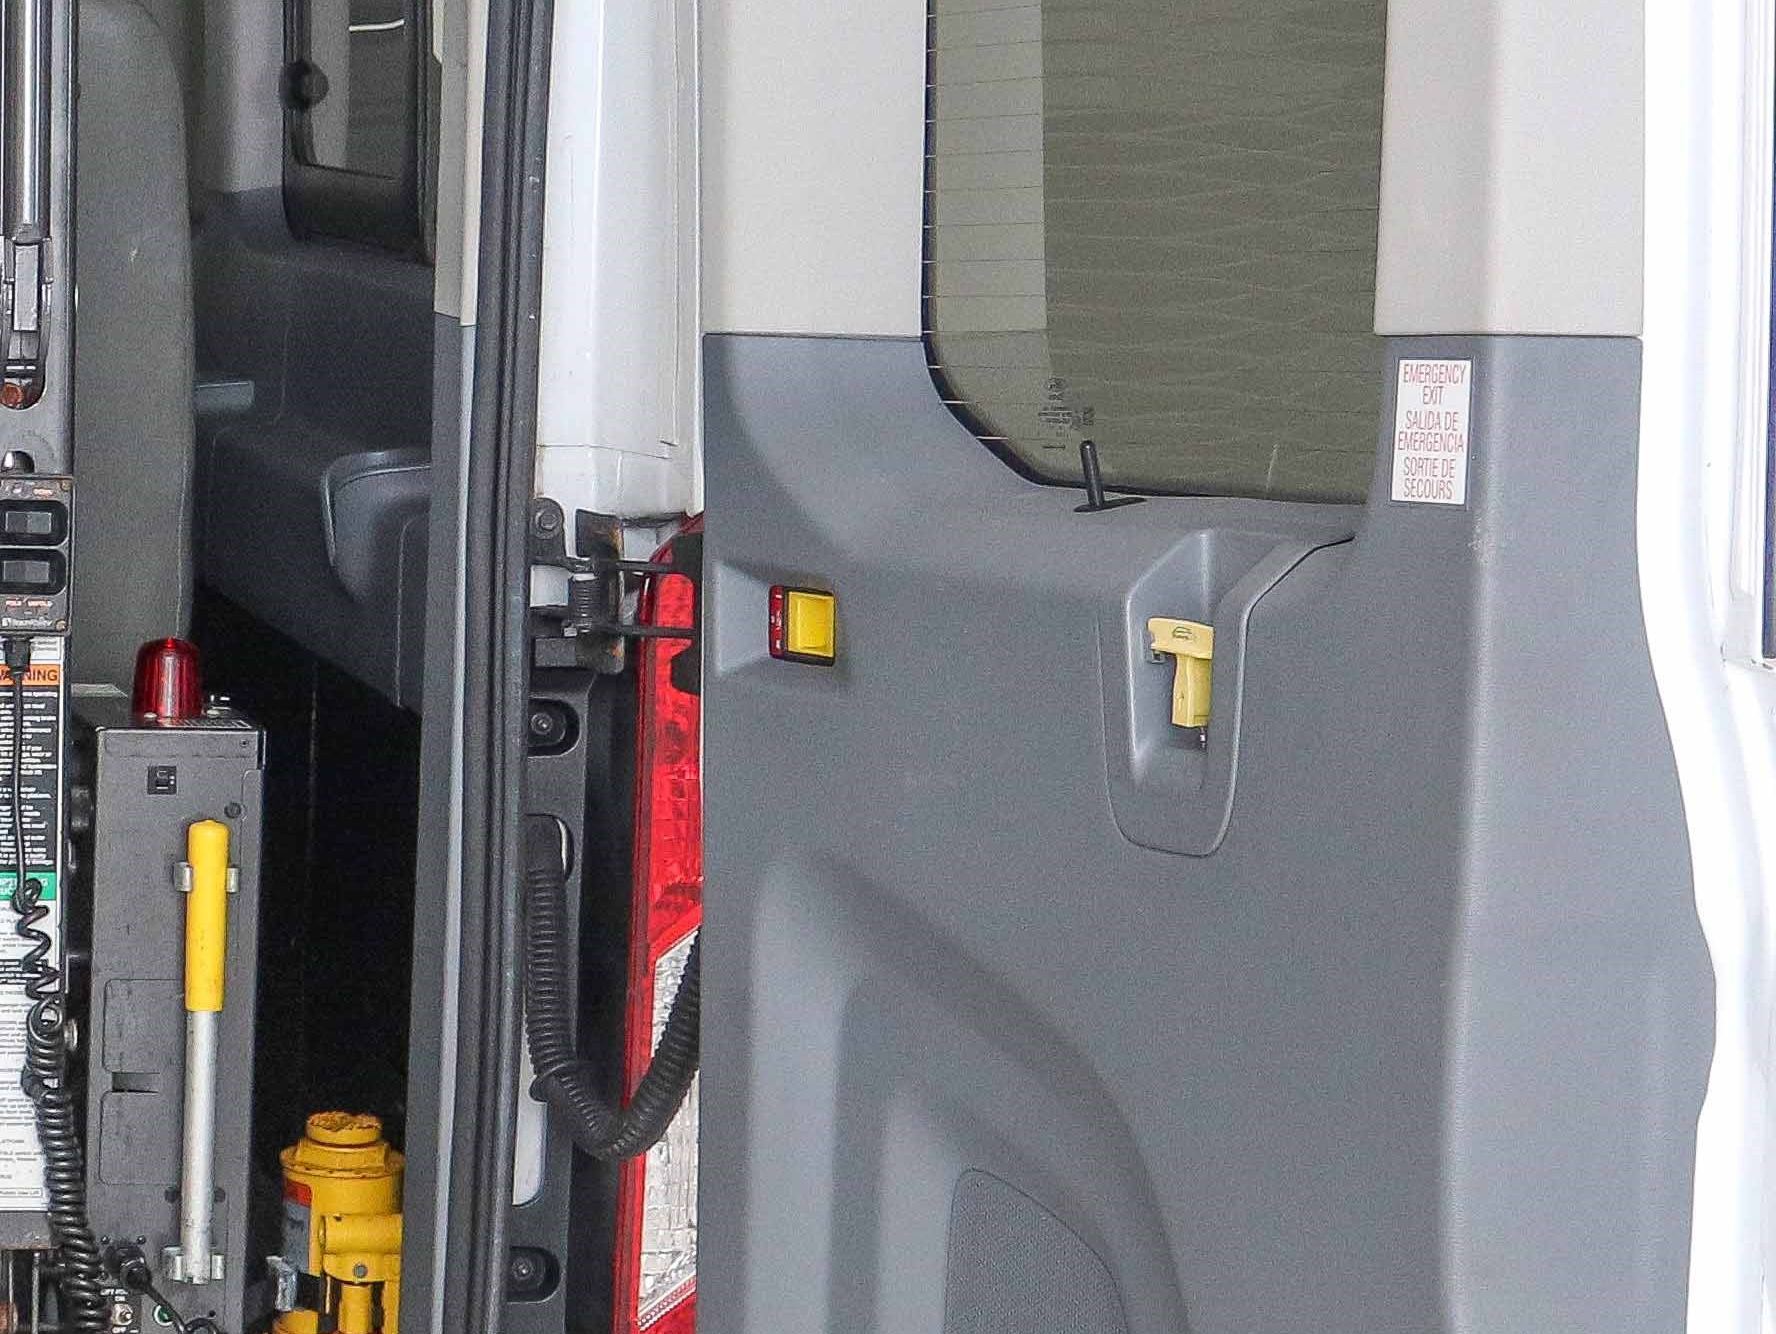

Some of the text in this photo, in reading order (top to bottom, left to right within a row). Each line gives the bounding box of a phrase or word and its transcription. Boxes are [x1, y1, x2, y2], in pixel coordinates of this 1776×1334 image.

[1402, 363, 1467, 384] EMERGENCY
[1422, 385, 1446, 405] EXIT
[1404, 410, 1459, 432] SALIDA DE
[1397, 431, 1465, 453] EMERGENCIA
[1403, 456, 1456, 478] SORTIE DE
[1403, 478, 1453, 500] SECOURS
